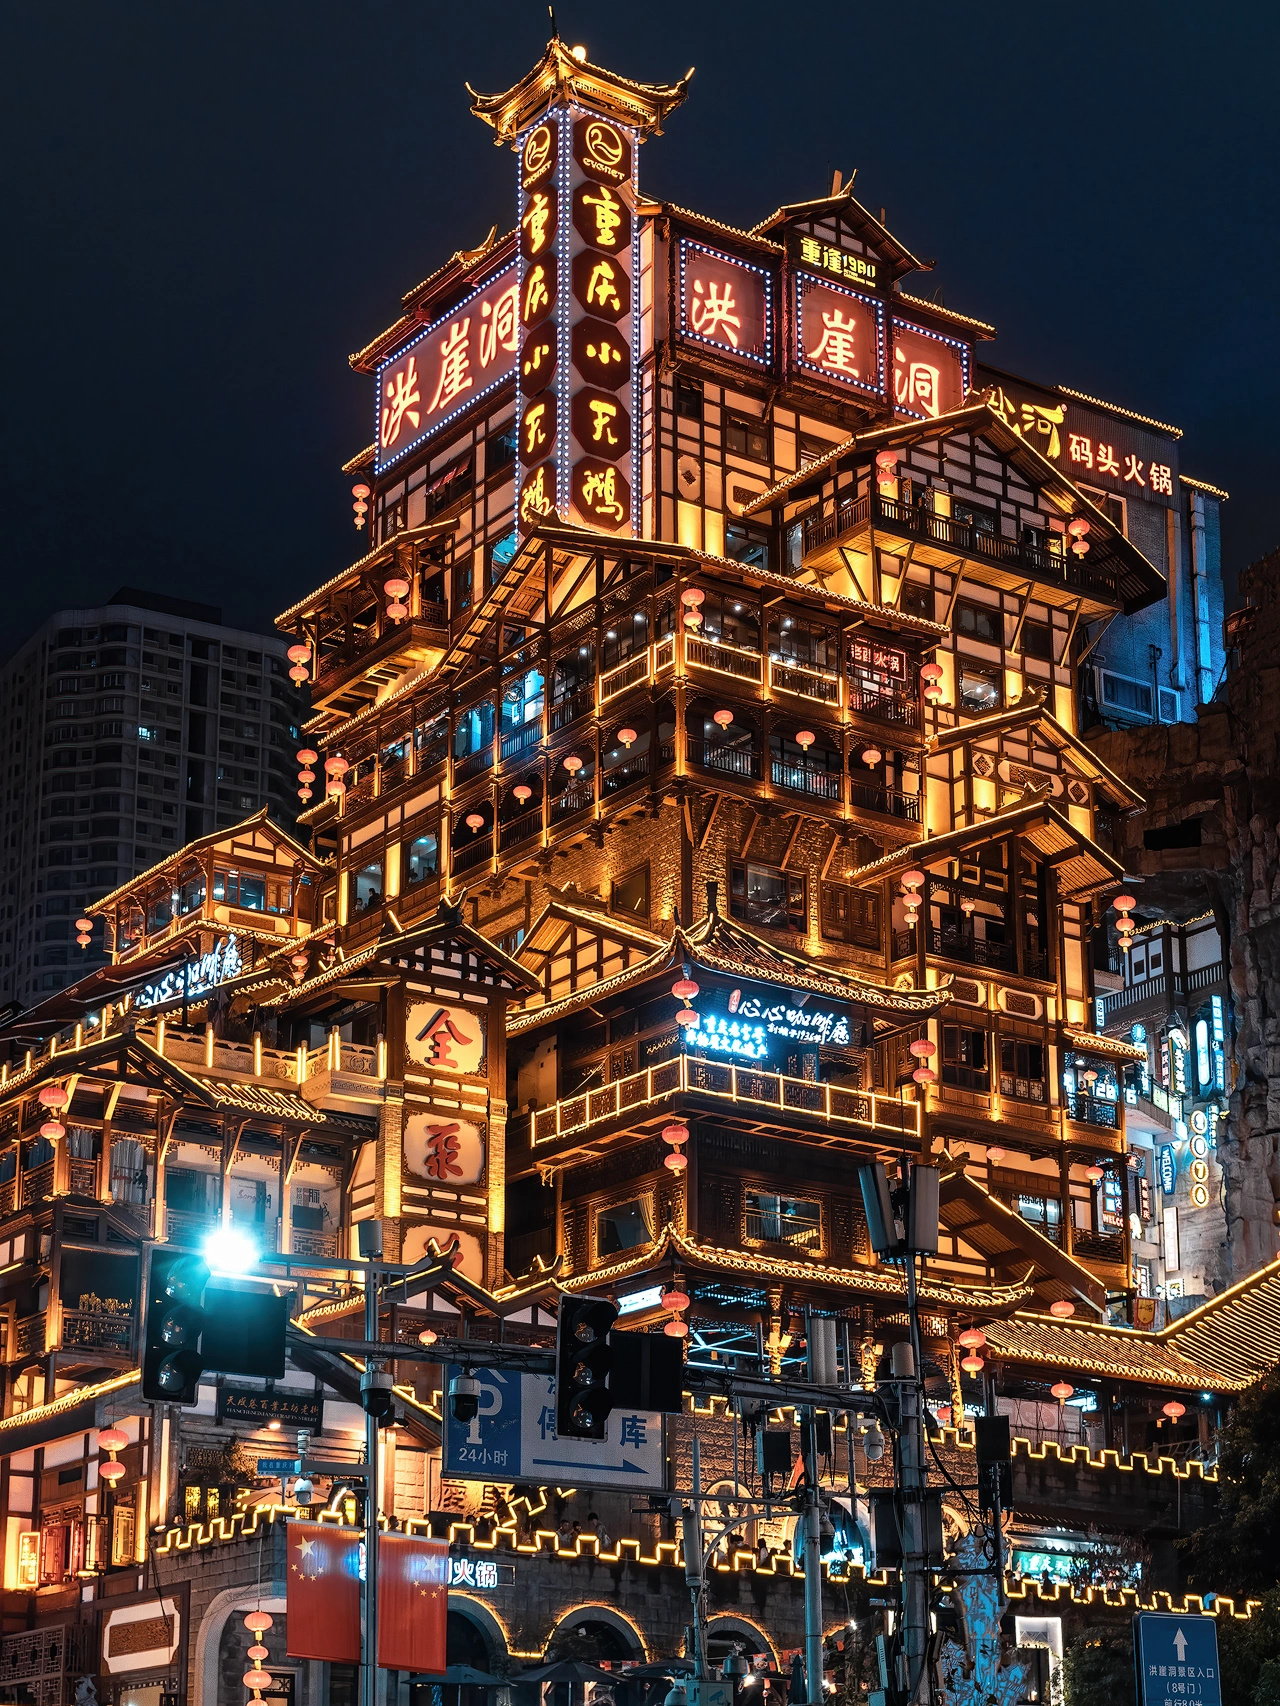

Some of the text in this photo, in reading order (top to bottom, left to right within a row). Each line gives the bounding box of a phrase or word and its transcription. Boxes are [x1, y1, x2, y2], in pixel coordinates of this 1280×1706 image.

[380, 284, 518, 446] 洪崖洞
[692, 279, 941, 417] 洪崖洞
[1069, 433, 1173, 496] 码头火锅
[1161, 1149, 1173, 1191] WELCOME
[537, 1405, 648, 1449] 停库
[458, 1447, 509, 1467] 24小时
[447, 1557, 498, 1588] 火锅
[1149, 1665, 1215, 1679] 洪崖洞景区入口
